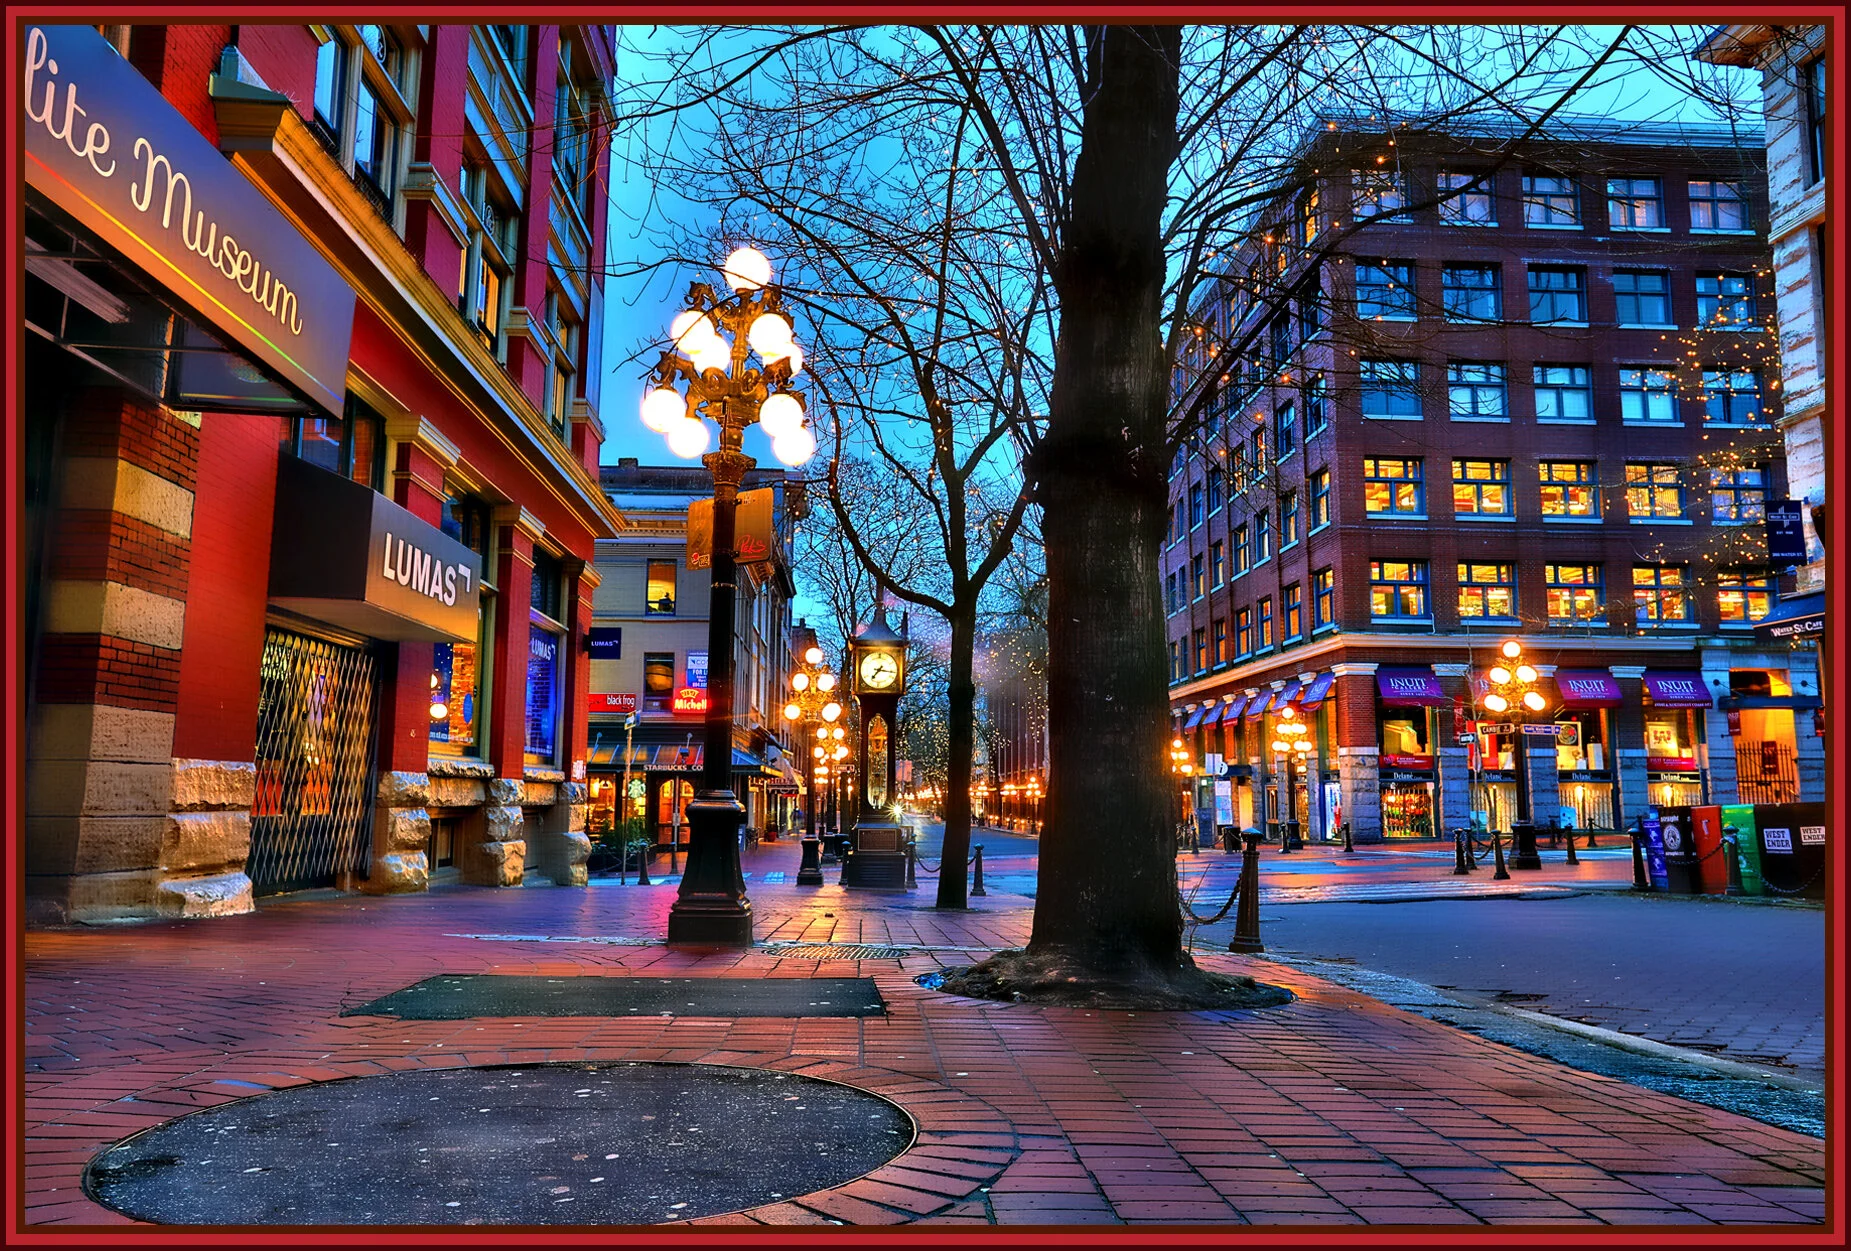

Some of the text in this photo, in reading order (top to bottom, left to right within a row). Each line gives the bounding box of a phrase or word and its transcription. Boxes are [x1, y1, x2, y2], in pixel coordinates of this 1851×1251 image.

[131, 137, 303, 336] Museum
[383, 532, 457, 607] LUMAS
[531, 637, 552, 661] LUMAS
[1390, 678, 1426, 687] INUIT
[1568, 680, 1605, 689] INUIT
[1657, 680, 1694, 689] INUIT
[606, 694, 635, 707] black frog
[1766, 830, 1786, 839] WEST
[1802, 827, 1822, 835] WEST
[1766, 839, 1791, 848] ENDER
